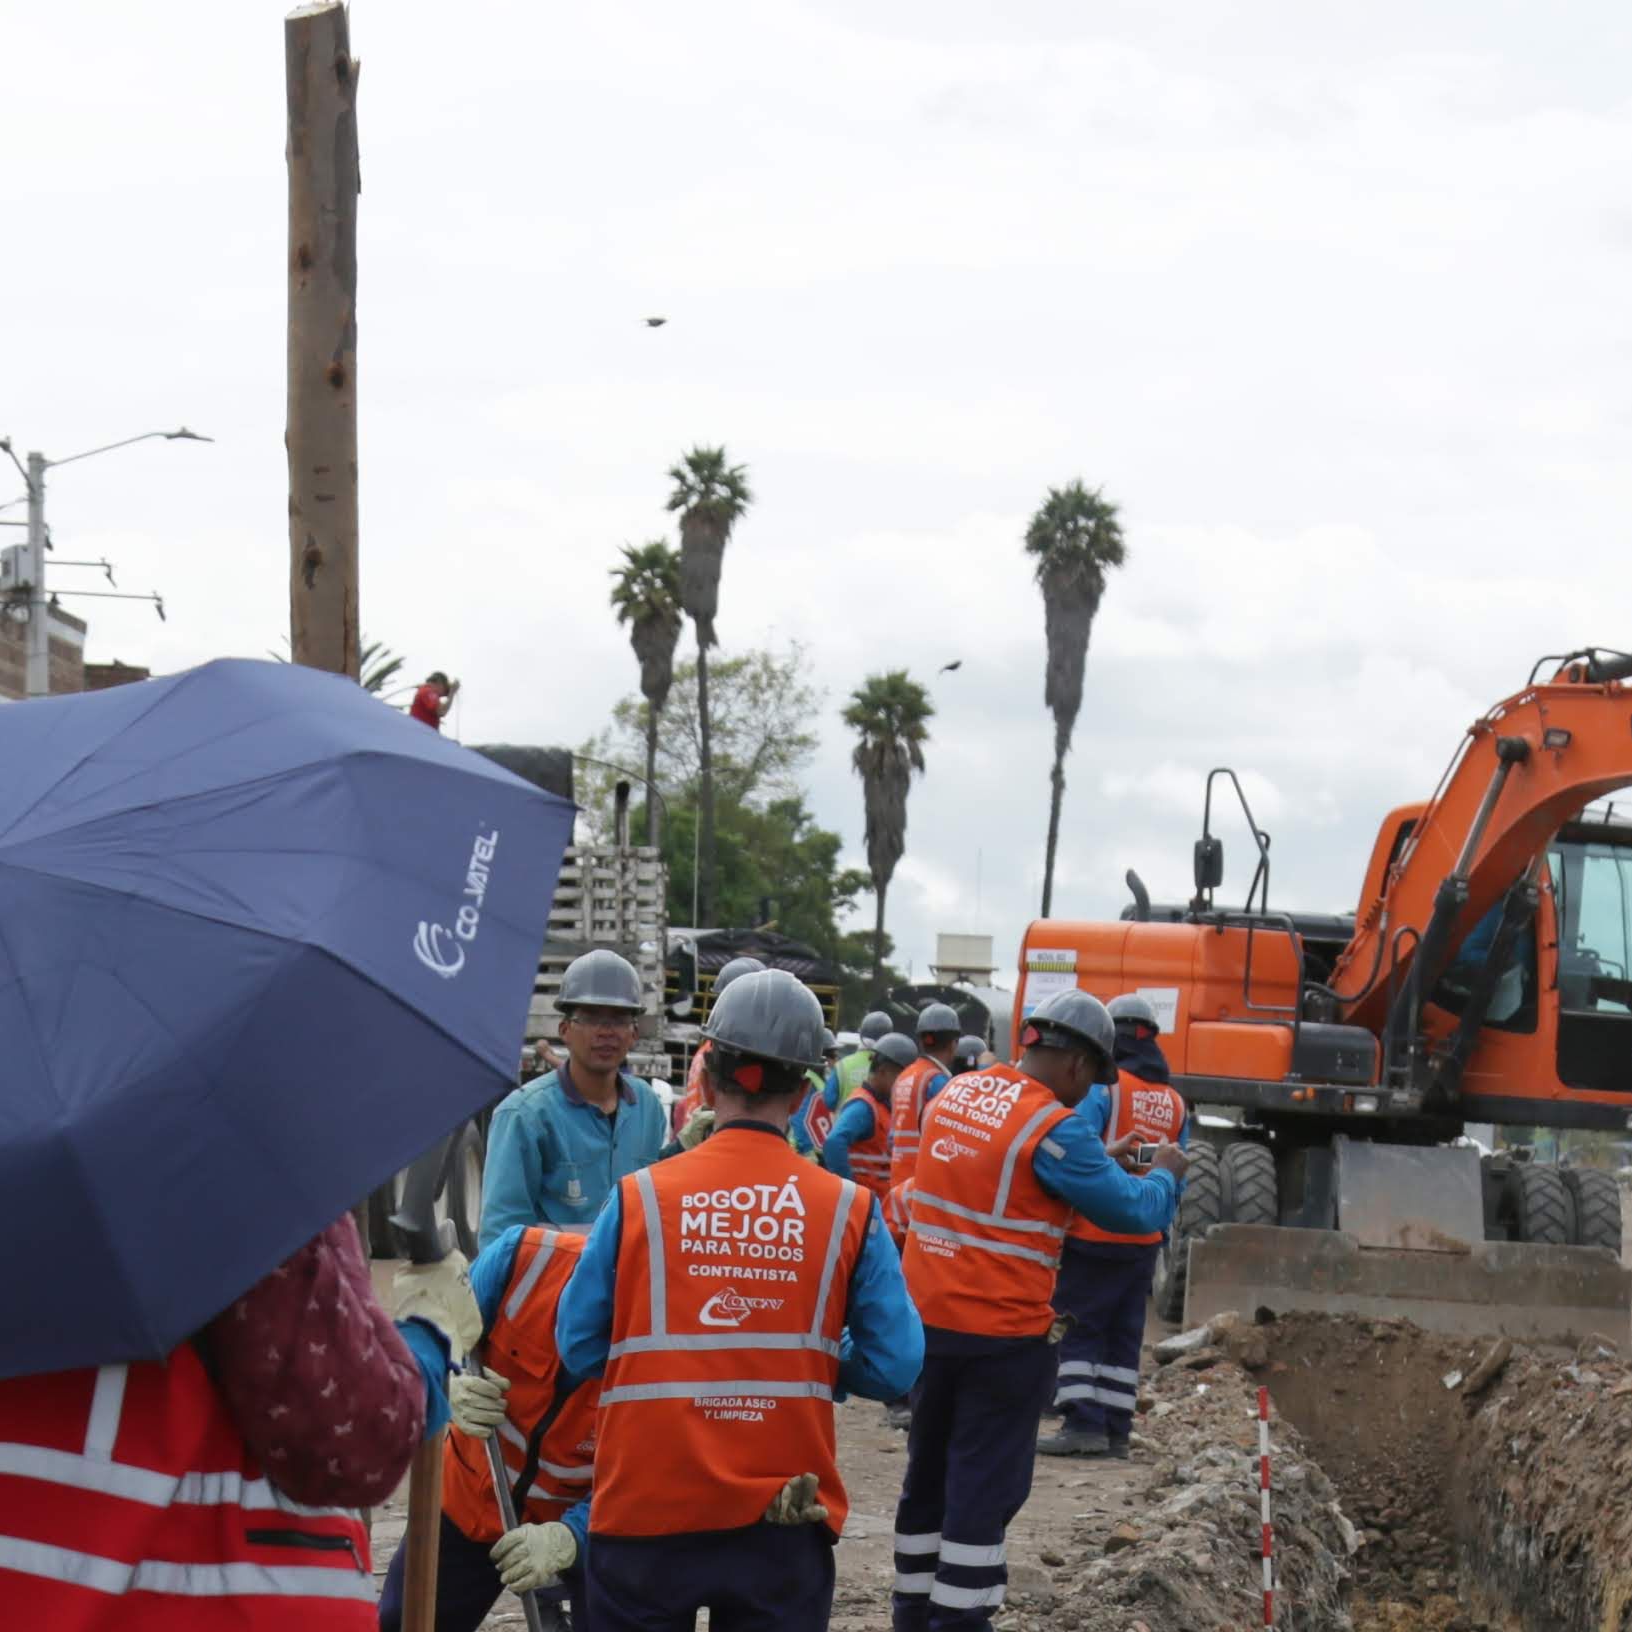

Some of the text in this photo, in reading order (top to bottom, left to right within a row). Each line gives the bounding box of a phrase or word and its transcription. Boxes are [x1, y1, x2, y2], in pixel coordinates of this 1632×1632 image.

[944, 1085, 1012, 1120] MEJOR
[934, 1115, 992, 1142] CONTRATISTA
[966, 1109, 1004, 1129] TODOS
[681, 1175, 806, 1217] BOGOTÁ
[681, 1210, 805, 1245] MEJOR
[681, 1239, 805, 1262] PARA TODOS
[688, 1264, 799, 1282] CONTRATISTA
[694, 1397, 777, 1410] BRIGADA ASEO
[704, 1410, 764, 1422] Y LIMPIEZA
